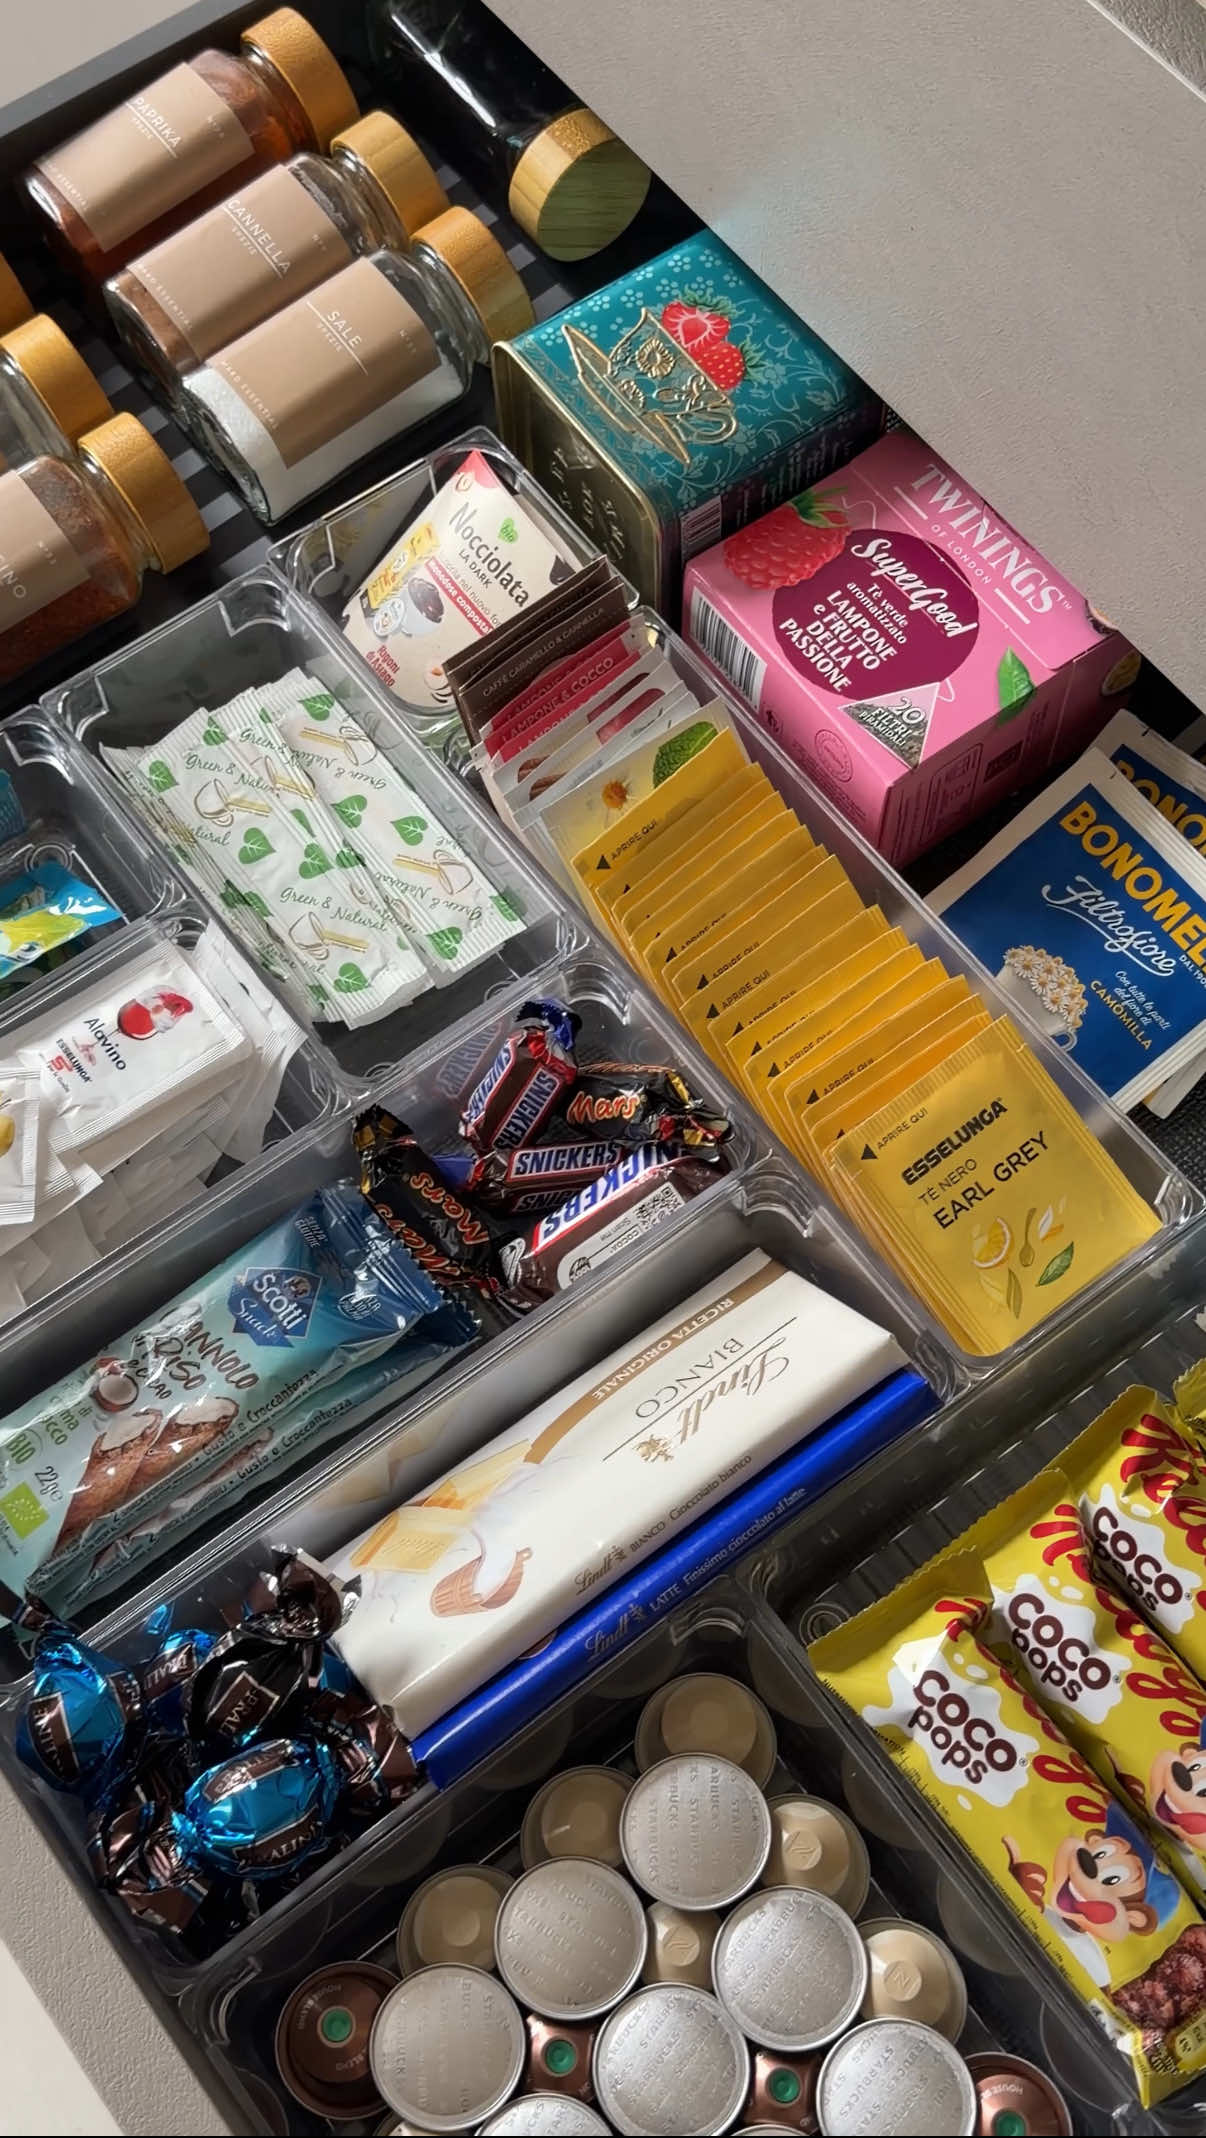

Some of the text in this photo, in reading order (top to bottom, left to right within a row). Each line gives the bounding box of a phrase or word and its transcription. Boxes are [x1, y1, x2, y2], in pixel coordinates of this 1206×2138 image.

[134, 96, 183, 148] PAPRIKA
[226, 199, 292, 277] CANNELLA
[326, 310, 363, 347] SALE
[449, 501, 530, 608] Nocciolata
[911, 463, 1064, 615] TWININGS
[930, 523, 993, 585] OF LONDON
[457, 549, 493, 589] LA DARK
[812, 602, 882, 671] e FRUTTO
[825, 590, 898, 662] LAMPONE
[846, 580, 908, 645] aromatizzato
[878, 597, 909, 629] verde
[779, 617, 853, 694] PASSIONE
[805, 620, 854, 671] DELLA
[566, 655, 617, 694] COCCO
[239, 728, 277, 750] Green
[857, 709, 907, 749] PIRAMIDALI
[870, 706, 913, 737] FILTRI
[889, 696, 926, 726] 20
[185, 753, 236, 775] Green &
[348, 770, 387, 790] Green
[610, 819, 659, 861] APRIRE QUI
[280, 886, 320, 906] Green
[320, 895, 333, 909] &
[329, 906, 389, 933] Natural
[442, 900, 482, 921] Green
[721, 970, 771, 1011] APRIRE QUI
[1090, 979, 1153, 1051] CAMOMILLA
[1113, 984, 1151, 1027] del fiore di
[1114, 968, 1133, 987] Con
[1127, 983, 1147, 1005] tutte
[1142, 999, 1155, 1012] le
[83, 1018, 127, 1071] Alavino
[493, 1070, 558, 1148] SNICKERS
[567, 1091, 640, 1125] Mars
[876, 1107, 929, 1150] APRIRE QUI
[515, 1142, 622, 1177] SNICKERS
[901, 1099, 1007, 1186] ESSELUNGA
[932, 1131, 1050, 1230] EARL GREY
[939, 1157, 978, 1194] NERO
[410, 1172, 489, 1246] Mars
[253, 1273, 307, 1330] Scotti
[590, 1297, 735, 1402] RICETTA ORIGINALE
[635, 1336, 745, 1419] BIANCO
[677, 1337, 789, 1444] Lindt
[5, 1432, 36, 1465] BIO
[236, 1453, 270, 1480] Gusto
[280, 1399, 353, 1448] Croccantezza
[574, 1454, 752, 1596] Lindt BIANCO Cioccolato bianco
[584, 1613, 630, 1661] Lindt
[649, 1582, 681, 1613] LATTE
[683, 1545, 728, 1586] Finissimo
[727, 1511, 775, 1553] cioccolato
[773, 1504, 787, 1521] al
[1093, 1506, 1183, 1605] coco
[1008, 1593, 1111, 1690] coco
[1013, 1626, 1084, 1703] pops
[907, 1704, 989, 1785] pops
[913, 1669, 1017, 1772] coco
